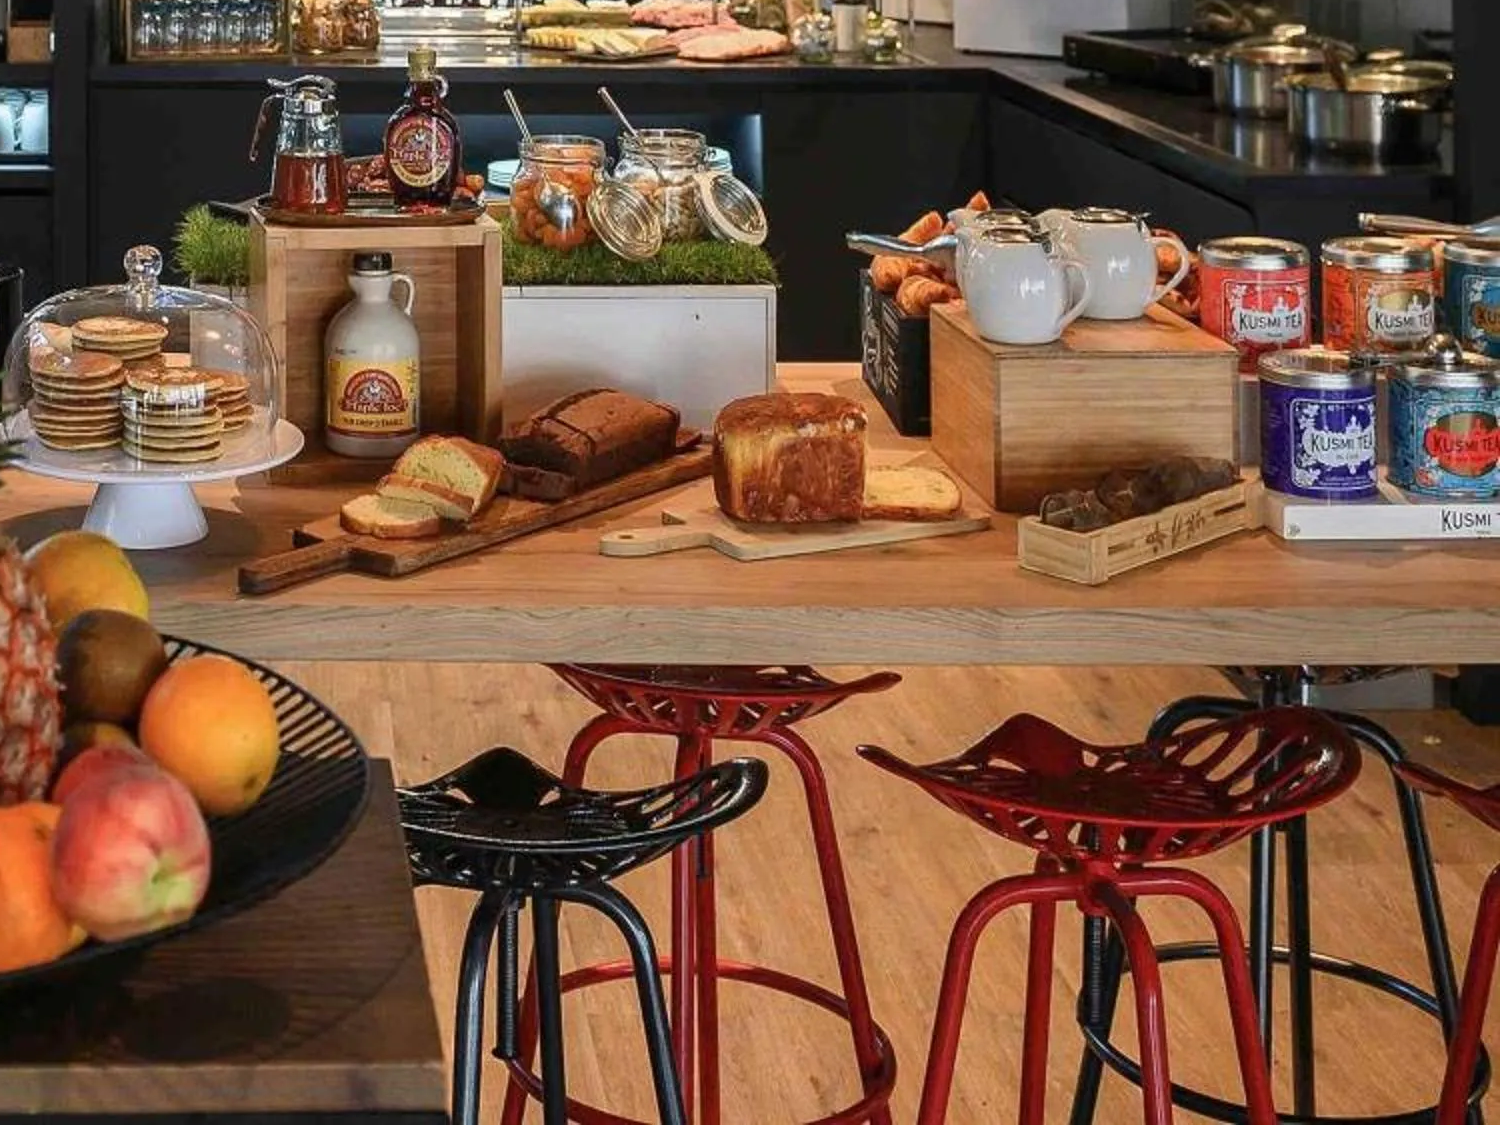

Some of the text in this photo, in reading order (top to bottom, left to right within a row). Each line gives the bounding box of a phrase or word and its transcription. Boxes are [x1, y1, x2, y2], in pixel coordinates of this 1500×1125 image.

[1239, 312, 1281, 331] KUSMI
[1375, 312, 1416, 330] KUSMI
[1311, 432, 1355, 452] KUSMI
[1432, 433, 1480, 453] KUSMI
[1441, 508, 1491, 532] KUSMI
